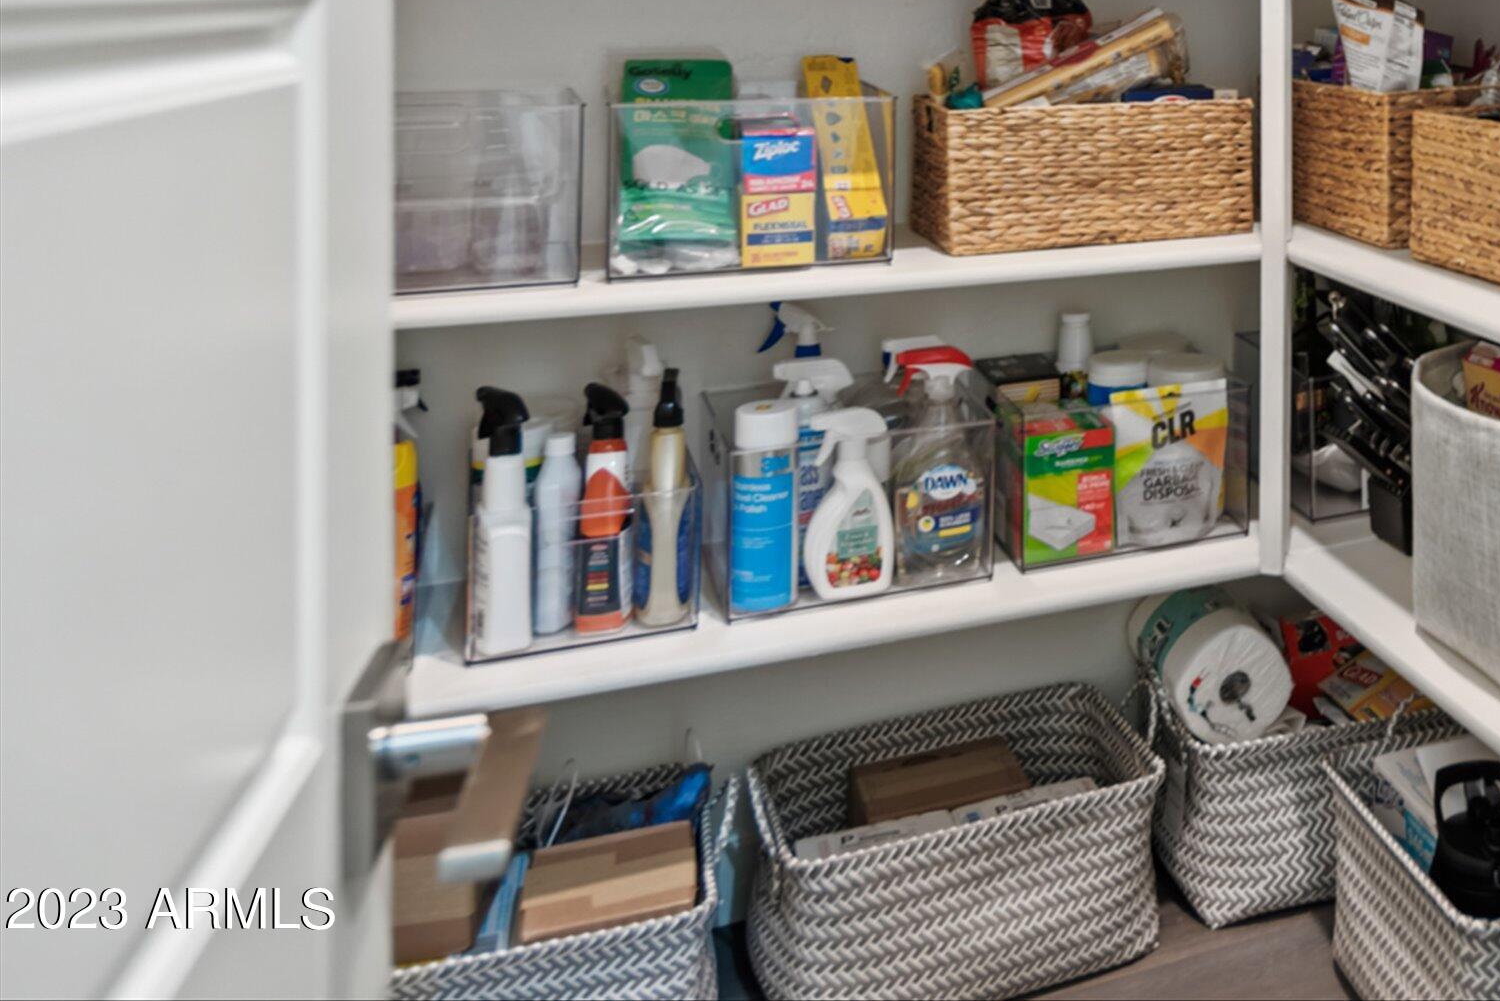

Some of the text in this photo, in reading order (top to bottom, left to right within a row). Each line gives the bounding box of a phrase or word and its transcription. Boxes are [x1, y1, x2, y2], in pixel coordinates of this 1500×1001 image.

[753, 139, 800, 161] Ziploc
[748, 197, 788, 217] GLAD
[1151, 410, 1196, 449] CLR
[924, 473, 968, 492] DAWN
